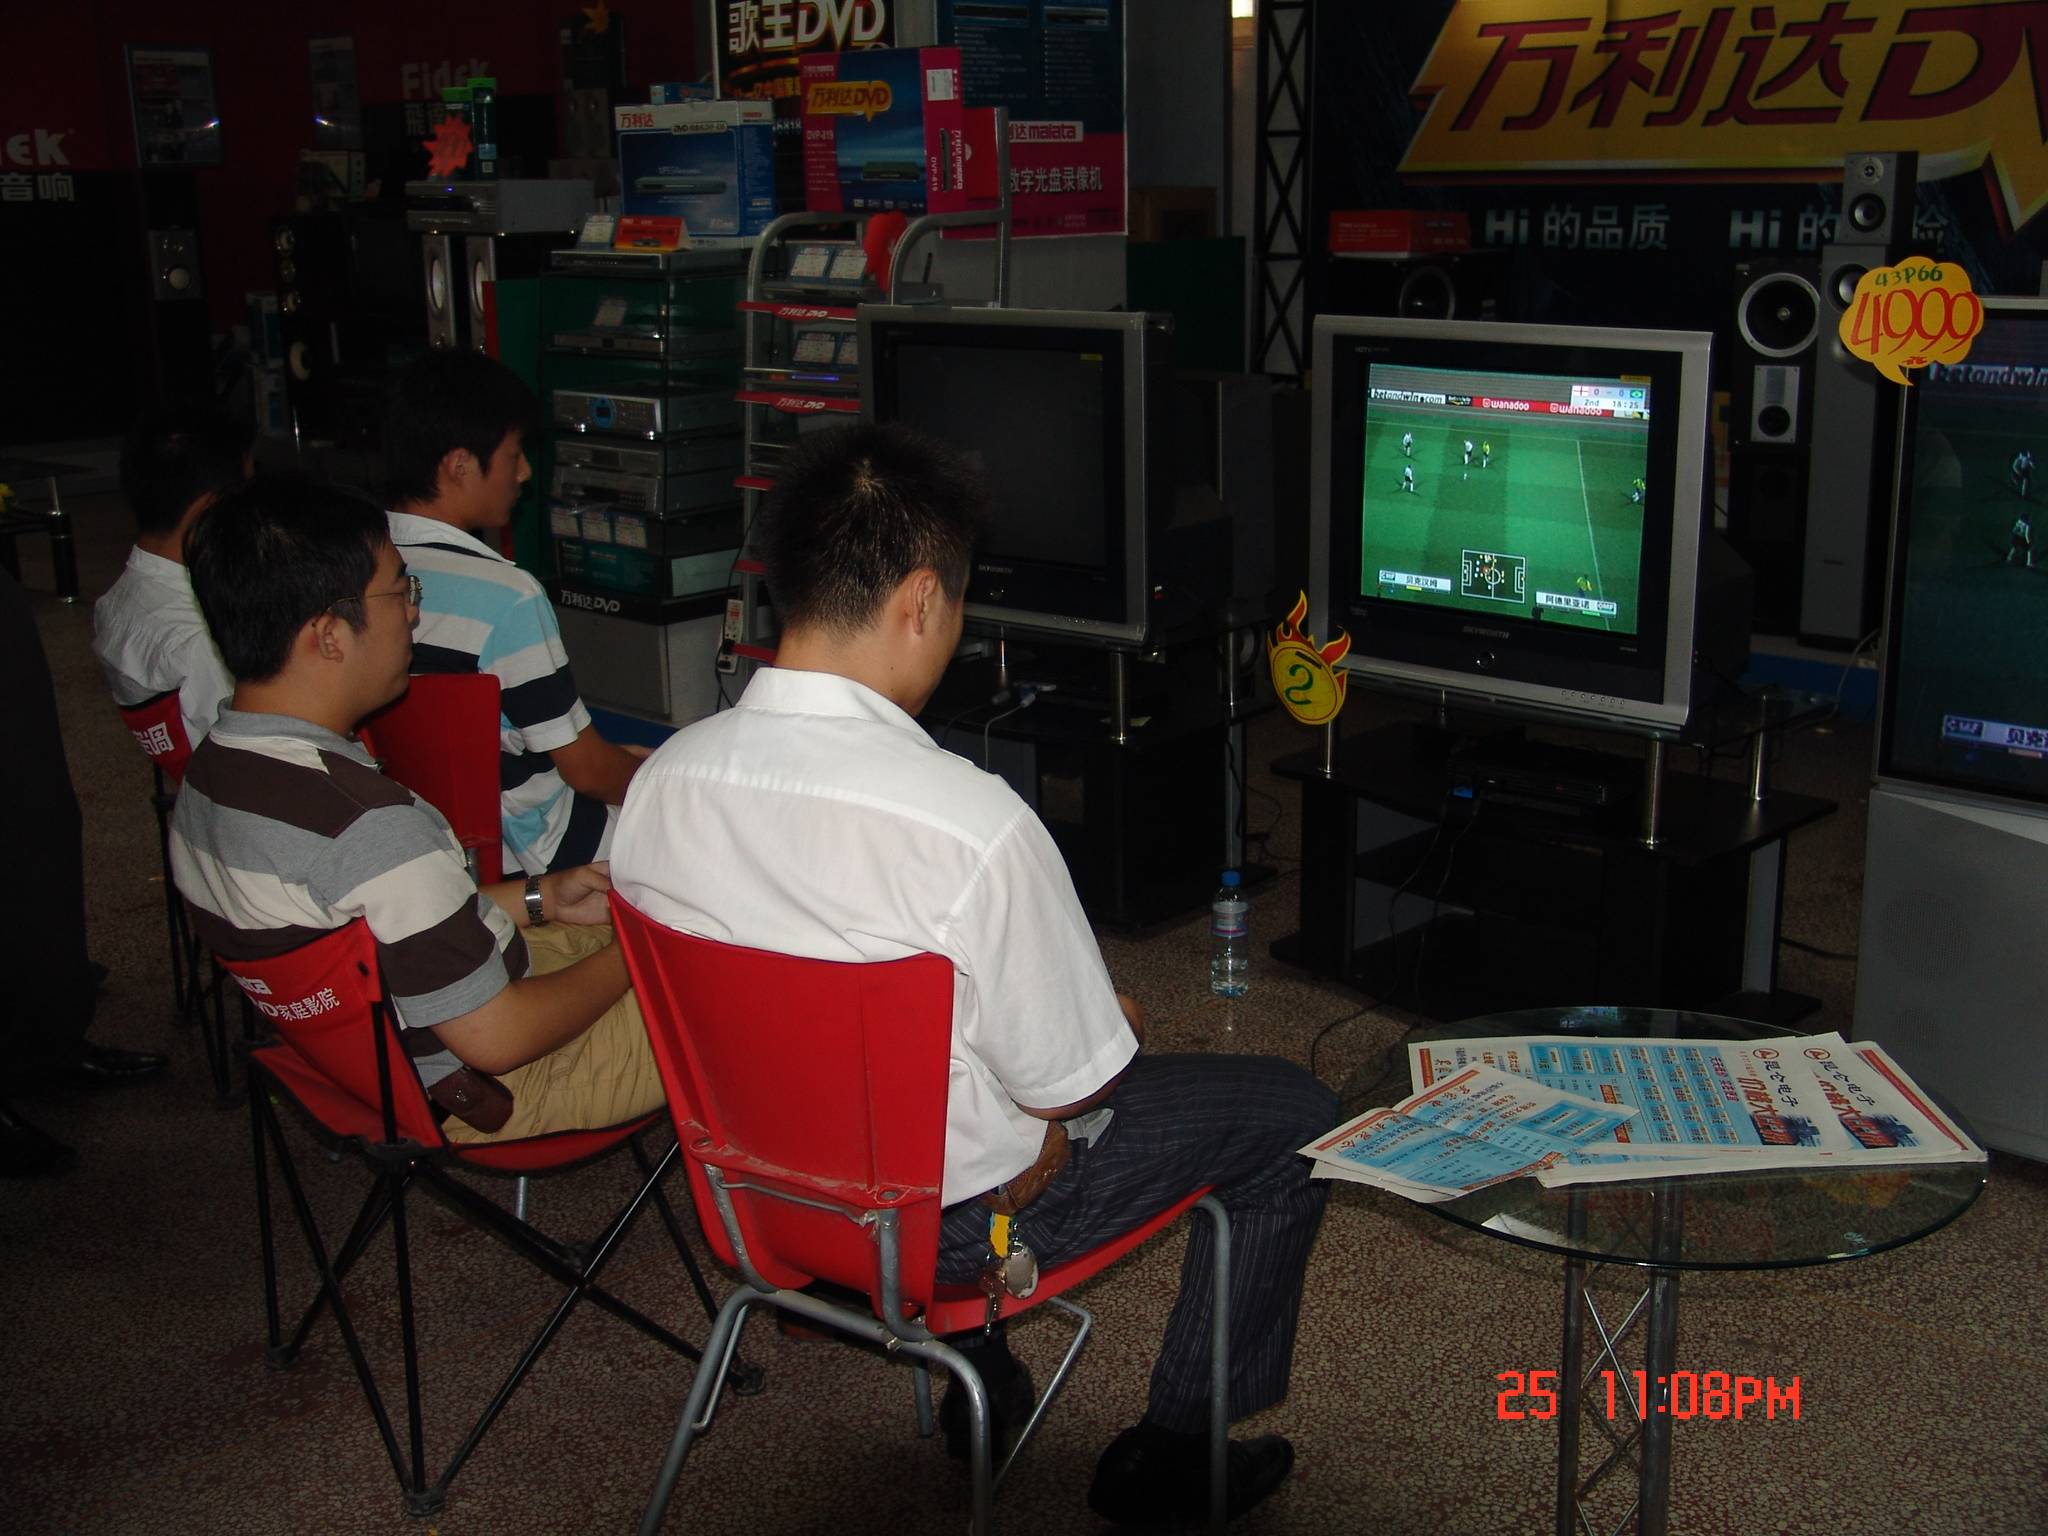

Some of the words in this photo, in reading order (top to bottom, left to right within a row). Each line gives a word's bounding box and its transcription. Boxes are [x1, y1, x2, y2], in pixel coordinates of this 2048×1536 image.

[728, 0, 886, 55] 歌王DVD
[620, 113, 655, 128] 万利达
[1484, 207, 1529, 246] Hi
[1542, 202, 1671, 252] 的品质
[1728, 207, 1782, 250] Hi
[1850, 286, 1980, 356] 4999
[1490, 399, 1530, 412] wanadoo
[1285, 663, 1313, 705] 2
